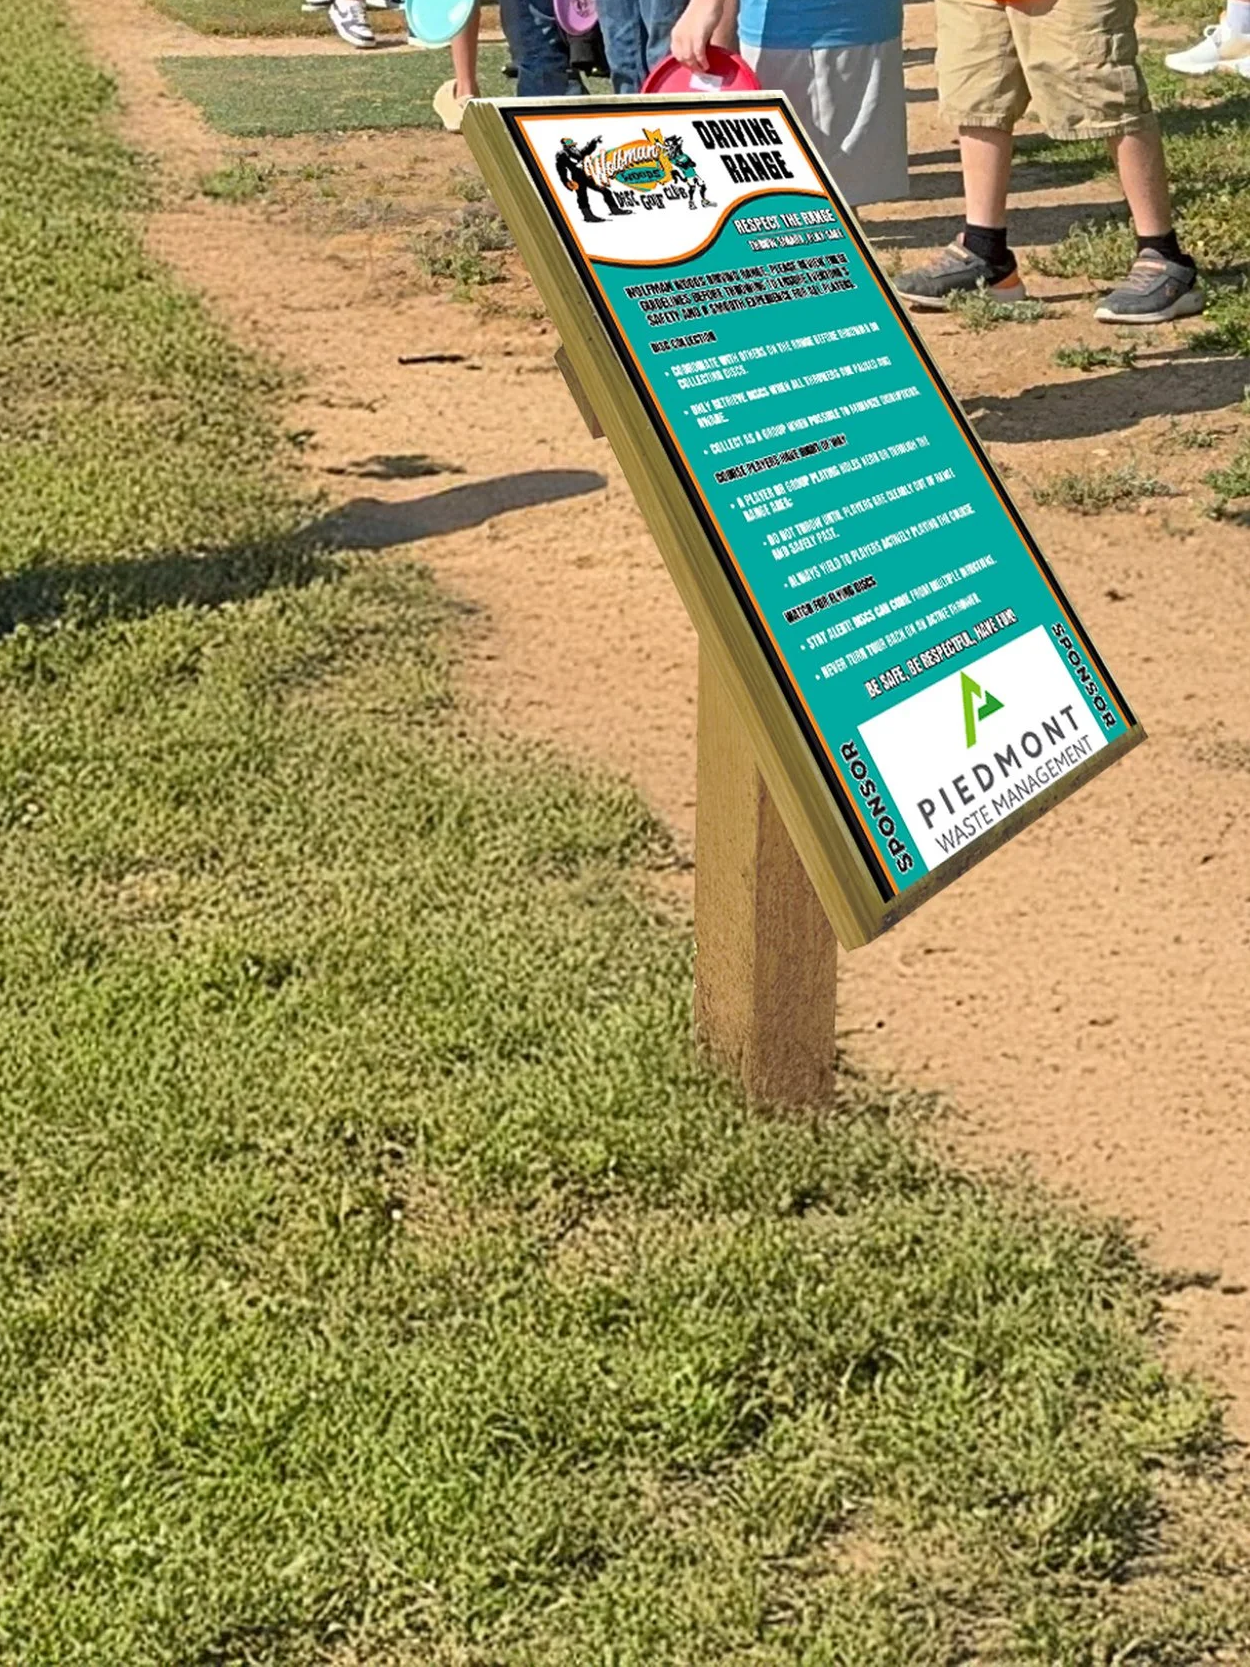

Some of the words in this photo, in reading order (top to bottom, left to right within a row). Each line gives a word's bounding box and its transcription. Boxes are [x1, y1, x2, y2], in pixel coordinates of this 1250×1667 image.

[692, 118, 783, 150] DRIVING
[620, 167, 661, 182] WOODS
[720, 150, 794, 184] RANGE
[613, 190, 640, 208] DISC
[640, 193, 664, 210] GOLF
[664, 183, 688, 201] CLUB
[734, 215, 781, 234] RESPECT
[780, 212, 802, 228] THE
[801, 209, 836, 224] RANGE
[623, 280, 673, 298] WOLFMAN
[639, 293, 691, 311] GUIDELINES
[690, 287, 723, 302] BEFORE
[645, 309, 681, 326] SAFETY
[680, 305, 701, 320] AND
[708, 297, 746, 314] SMOOTH
[649, 338, 671, 354] DISC
[670, 330, 716, 349] COLLECTION
[671, 357, 719, 376] COORDINATE
[717, 353, 739, 365] WITH
[738, 346, 766, 361] OTHERS
[765, 344, 778, 355] ON
[776, 340, 792, 352] THE
[677, 370, 723, 389] COLLECTING
[722, 364, 748, 378] DISCS.
[690, 401, 711, 415] ONLY
[711, 392, 747, 409] RETRIEVE
[746, 386, 769, 400] DISCS
[768, 381, 791, 394] WHEN
[790, 378, 804, 389] ALL
[803, 369, 840, 385] THROWERS
[709, 436, 743, 454] COLLECT
[742, 432, 755, 444] AS
[754, 430, 762, 441] A
[761, 423, 785, 439] GROUP
[786, 418, 808, 431] WHEN
[807, 408, 840, 425] POSSIBLE
[838, 405, 850, 416] TO
[713, 463, 748, 484] COURSE
[745, 453, 780, 474] PLAYERS
[778, 447, 800, 464] HAVE
[818, 437, 831, 451] OF
[736, 496, 745, 508] A
[743, 487, 774, 505] PLAYER
[772, 483, 786, 495] OR
[784, 475, 809, 491] GROUP
[809, 465, 840, 483] PLAYING
[838, 458, 861, 473] HOLES
[877, 448, 890, 460] OR
[743, 503, 770, 521] RANGE
[766, 532, 780, 545] DO
[778, 526, 795, 541] NOT
[794, 516, 822, 534] THROW
[821, 509, 843, 525] UNTIL
[842, 498, 873, 516] PLAYERS
[871, 493, 887, 506] ARE
[885, 483, 913, 501] CLEARLY
[771, 545, 789, 560] AND
[788, 534, 816, 553] SAFELY
[816, 527, 839, 543] PAST.
[788, 565, 820, 587] ALWAYS
[818, 557, 841, 574] YIELD
[839, 553, 852, 565] TO
[850, 540, 882, 561] PLAYERS
[881, 529, 911, 549] ACTIVELY
[782, 601, 813, 624] WATCH
[811, 594, 829, 612] FOR
[826, 583, 855, 605] FLYING
[852, 574, 876, 594] DISCS
[806, 631, 827, 649] STAY
[827, 619, 854, 639] ALERT!
[851, 609, 875, 627] DISCS
[873, 602, 891, 617] CAN
[889, 592, 911, 610] COME
[909, 583, 931, 600] FROM
[820, 657, 847, 678] NEVER
[845, 647, 867, 665] TURN
[865, 638, 887, 655] YOUR
[885, 628, 906, 646] BACK
[904, 623, 917, 636] ON
[925, 607, 950, 626] ACTIVE
[864, 677, 882, 699] BE
[878, 665, 910, 690] SAFE,
[906, 657, 922, 676] BE
[919, 631, 977, 669] RESPECTFUL,
[973, 616, 998, 640] HAVE
[995, 608, 1017, 629] FUN!
[1052, 622, 1118, 729] SPONSOR
[917, 704, 1080, 830] PIEDMONT
[838, 740, 914, 873] SPONSOR
[934, 806, 994, 854] WASTE
[992, 734, 1093, 818] MANAGEMENT
